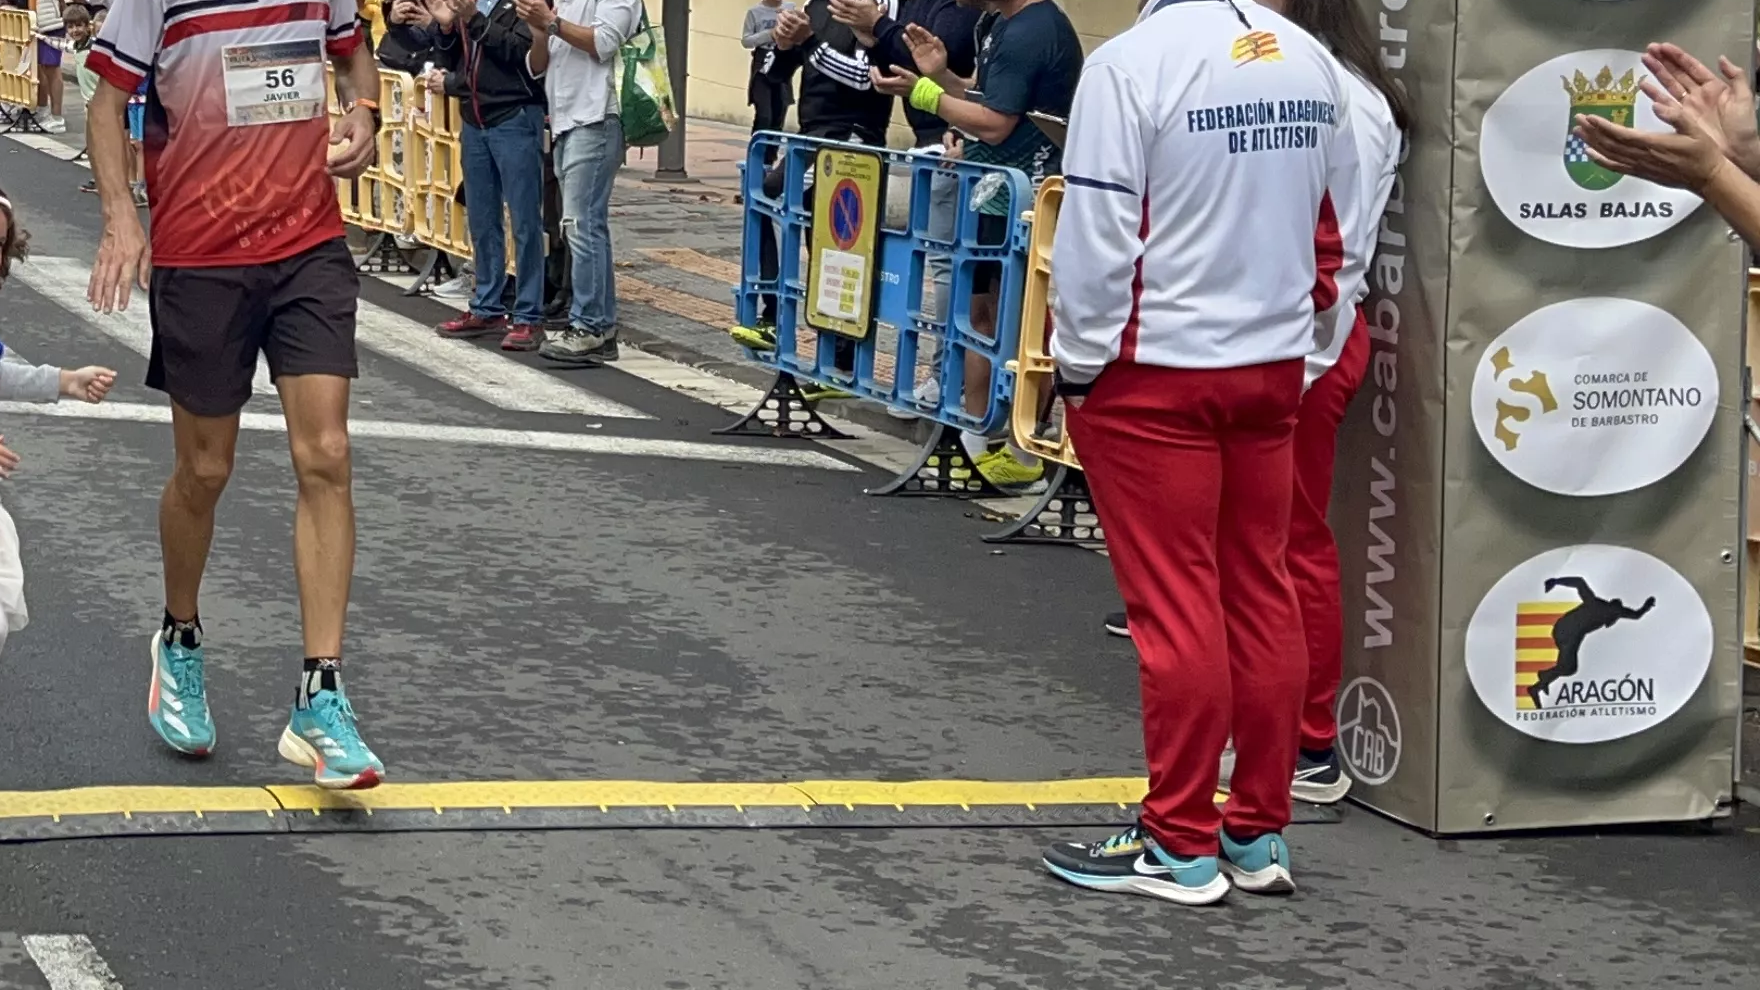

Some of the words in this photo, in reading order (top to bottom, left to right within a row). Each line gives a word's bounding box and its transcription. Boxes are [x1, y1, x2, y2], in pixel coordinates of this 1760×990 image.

[265, 68, 295, 89] 56
[263, 91, 301, 102] JAVIER
[1187, 97, 1276, 133] FEDERACIÓN
[1228, 129, 1248, 154] DE
[1520, 202, 1587, 219] SALAS
[1600, 201, 1673, 219] BAJAS
[1574, 373, 1630, 386] COMARCA
[1634, 371, 1648, 384] DE
[1572, 386, 1702, 410] SOMONTANO
[1571, 416, 1587, 428] DE
[1590, 413, 1659, 427] BARBASTRO
[1555, 673, 1654, 707] ARAGÓN
[1515, 706, 1586, 722] FEDERACIÓN
[1590, 706, 1657, 718] ATLETISMO
[1351, 725, 1386, 775] CAB
